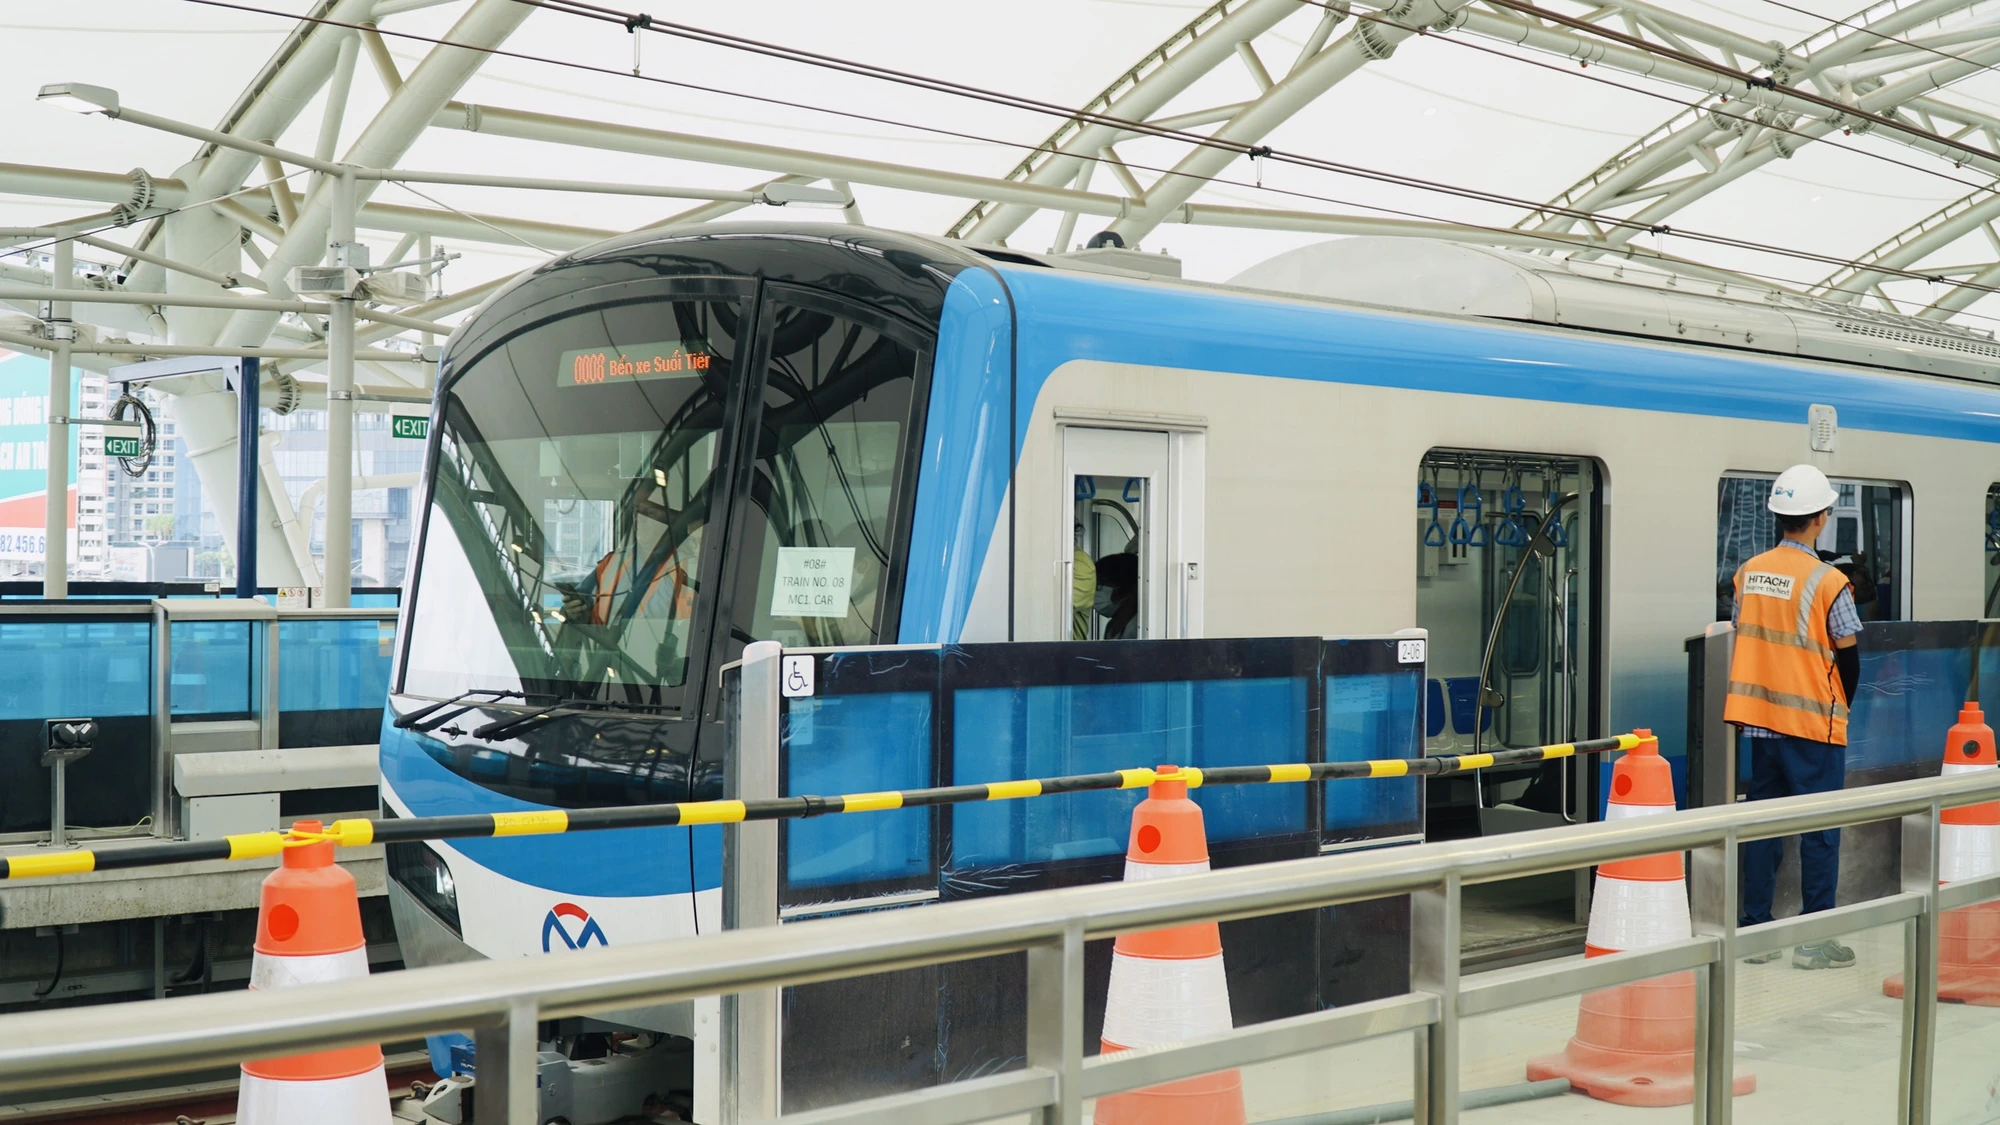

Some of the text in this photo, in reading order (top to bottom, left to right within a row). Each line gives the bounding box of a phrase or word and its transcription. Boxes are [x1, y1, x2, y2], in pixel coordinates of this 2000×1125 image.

[609, 354, 633, 376] Bến
[636, 362, 651, 374] xe
[654, 350, 682, 372] Suối
[402, 419, 429, 436] EXIT
[113, 439, 137, 454] EXIT
[803, 559, 827, 570] #08#
[782, 576, 845, 588] TRAIN NO. 08
[1748, 574, 1790, 589] HITACHI
[787, 594, 834, 605] MC1. CAR
[1402, 642, 1421, 660] 2-06
